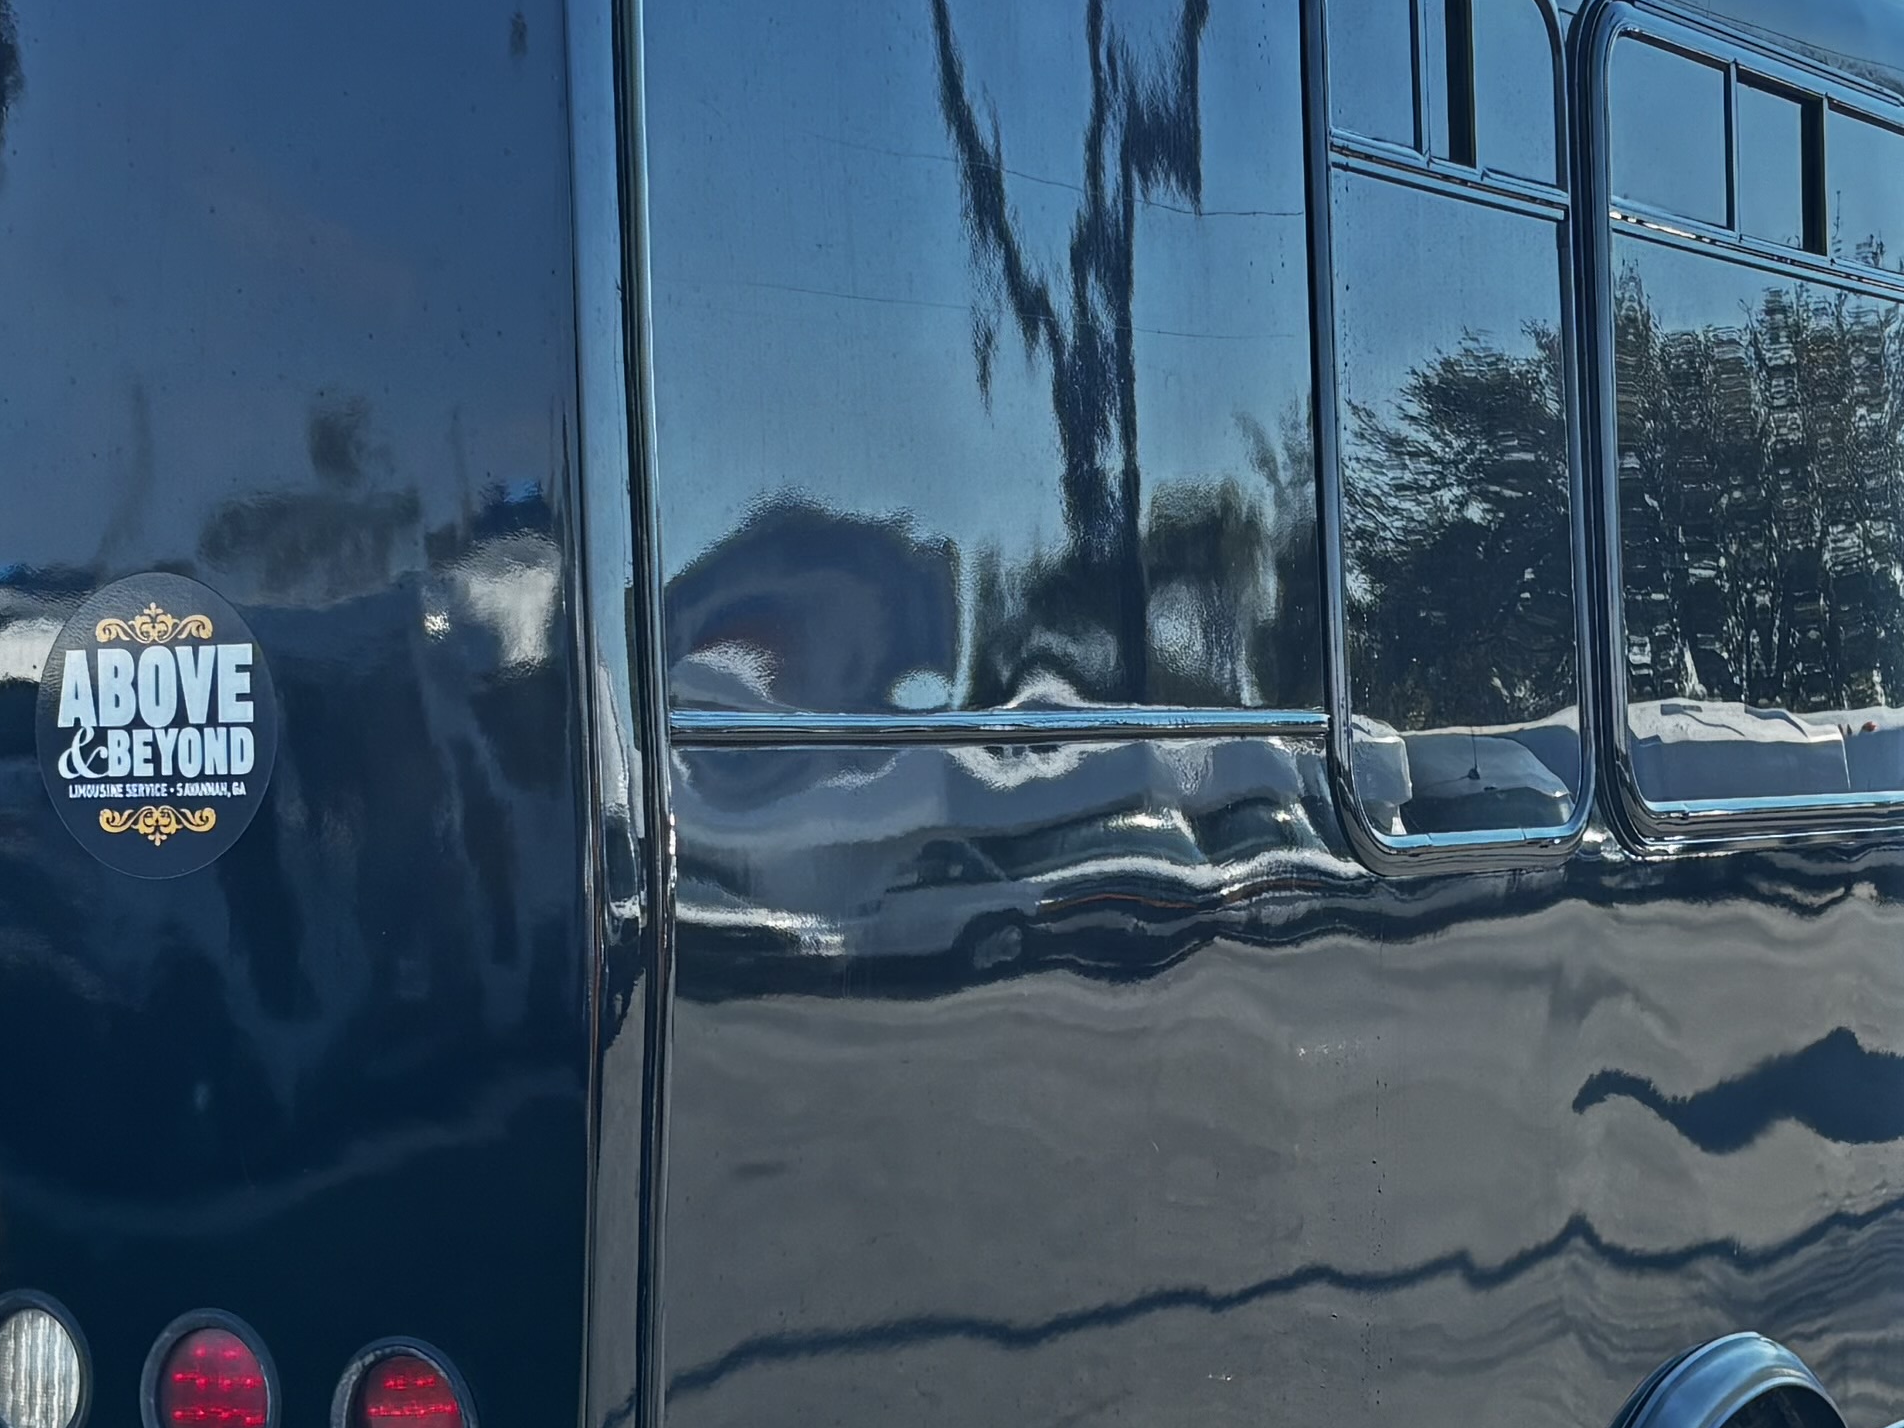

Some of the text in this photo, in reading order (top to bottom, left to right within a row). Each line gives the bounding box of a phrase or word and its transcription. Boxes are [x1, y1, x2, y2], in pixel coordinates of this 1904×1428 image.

[57, 643, 254, 728] ABOVE
[57, 726, 255, 779] & BEYOND
[69, 783, 124, 798] LIMOUSINE
[125, 783, 168, 797] SERVICE
[232, 782, 247, 796] GA
